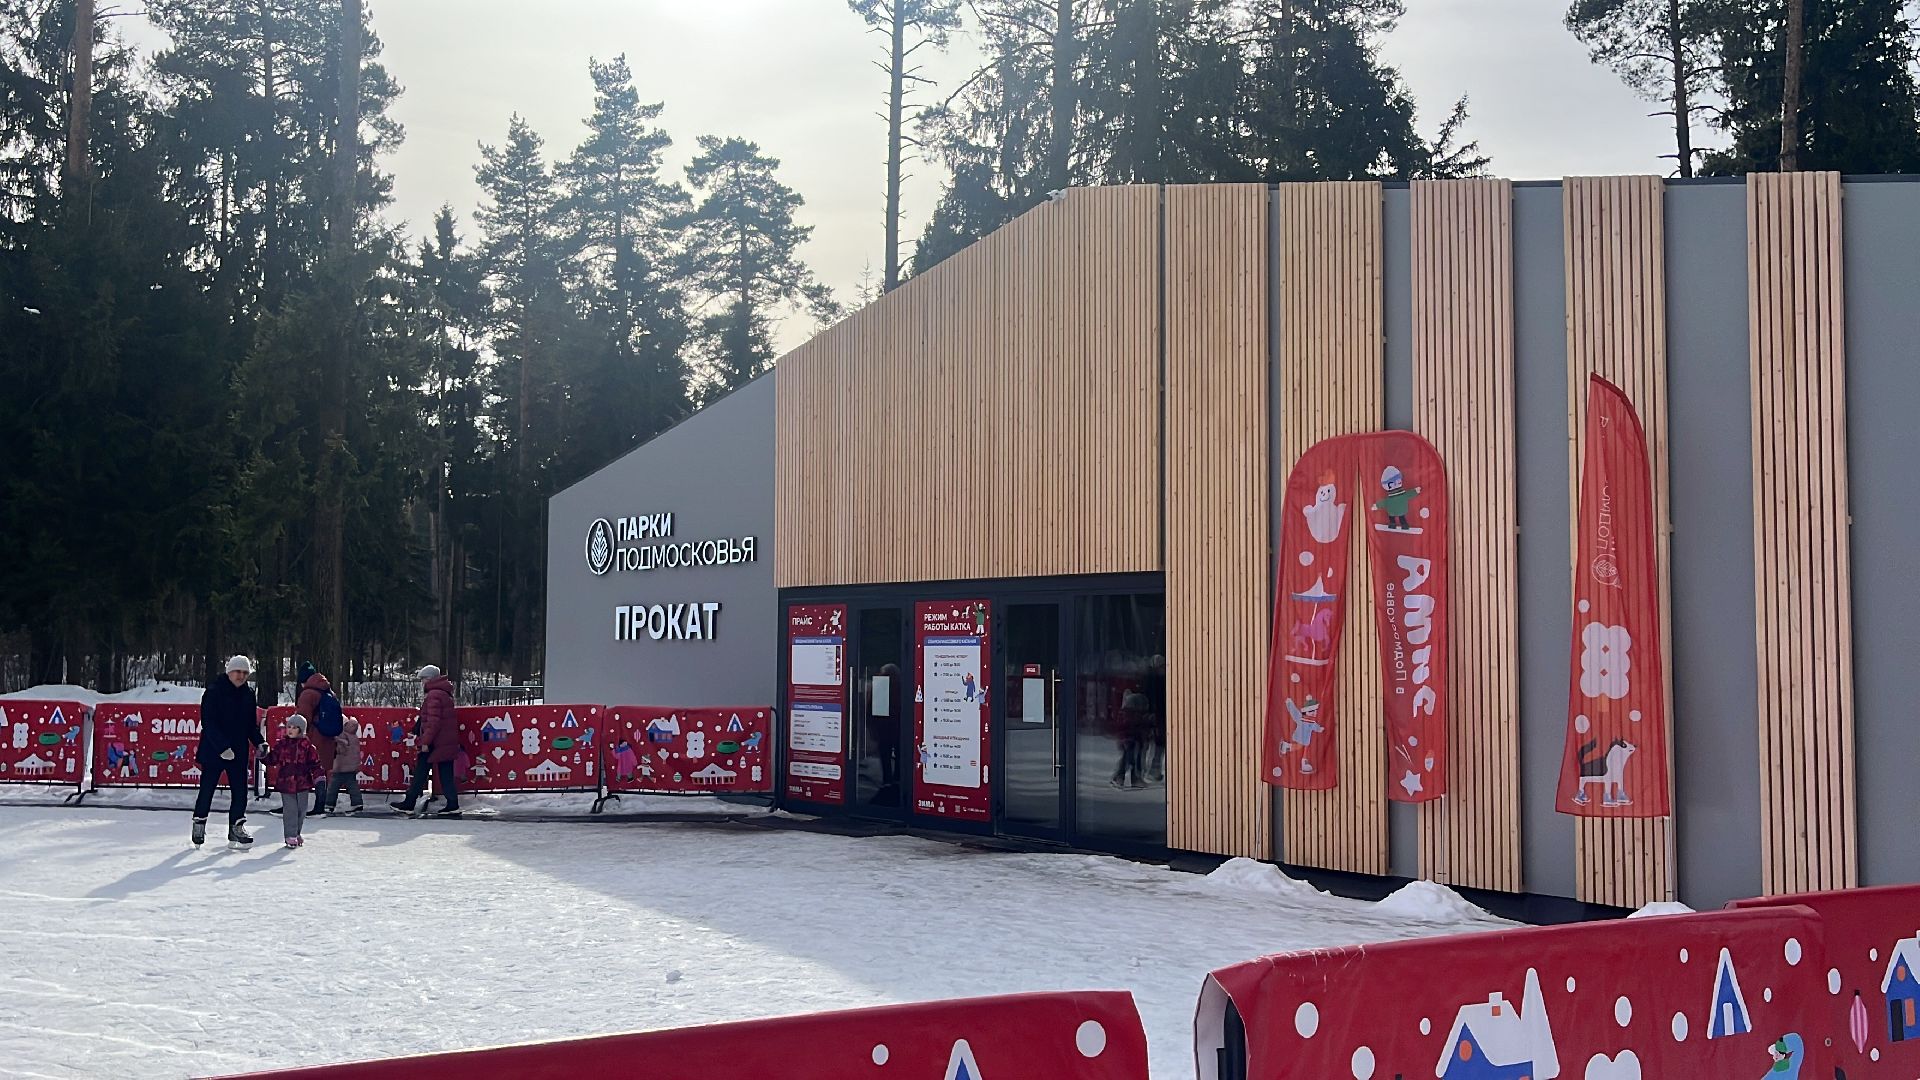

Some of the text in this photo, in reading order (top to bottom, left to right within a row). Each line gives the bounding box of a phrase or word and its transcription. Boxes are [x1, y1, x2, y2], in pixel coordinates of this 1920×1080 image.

[617, 512, 672, 541] ПАРКИ
[616, 536, 755, 572] ПОДМОСКОВЬЯ
[615, 602, 719, 641] ПРОКАТ
[792, 615, 813, 626] ПРАЙС
[924, 613, 948, 621] РЕЖИМ
[924, 622, 971, 631] РАБОТЫ КАТКА
